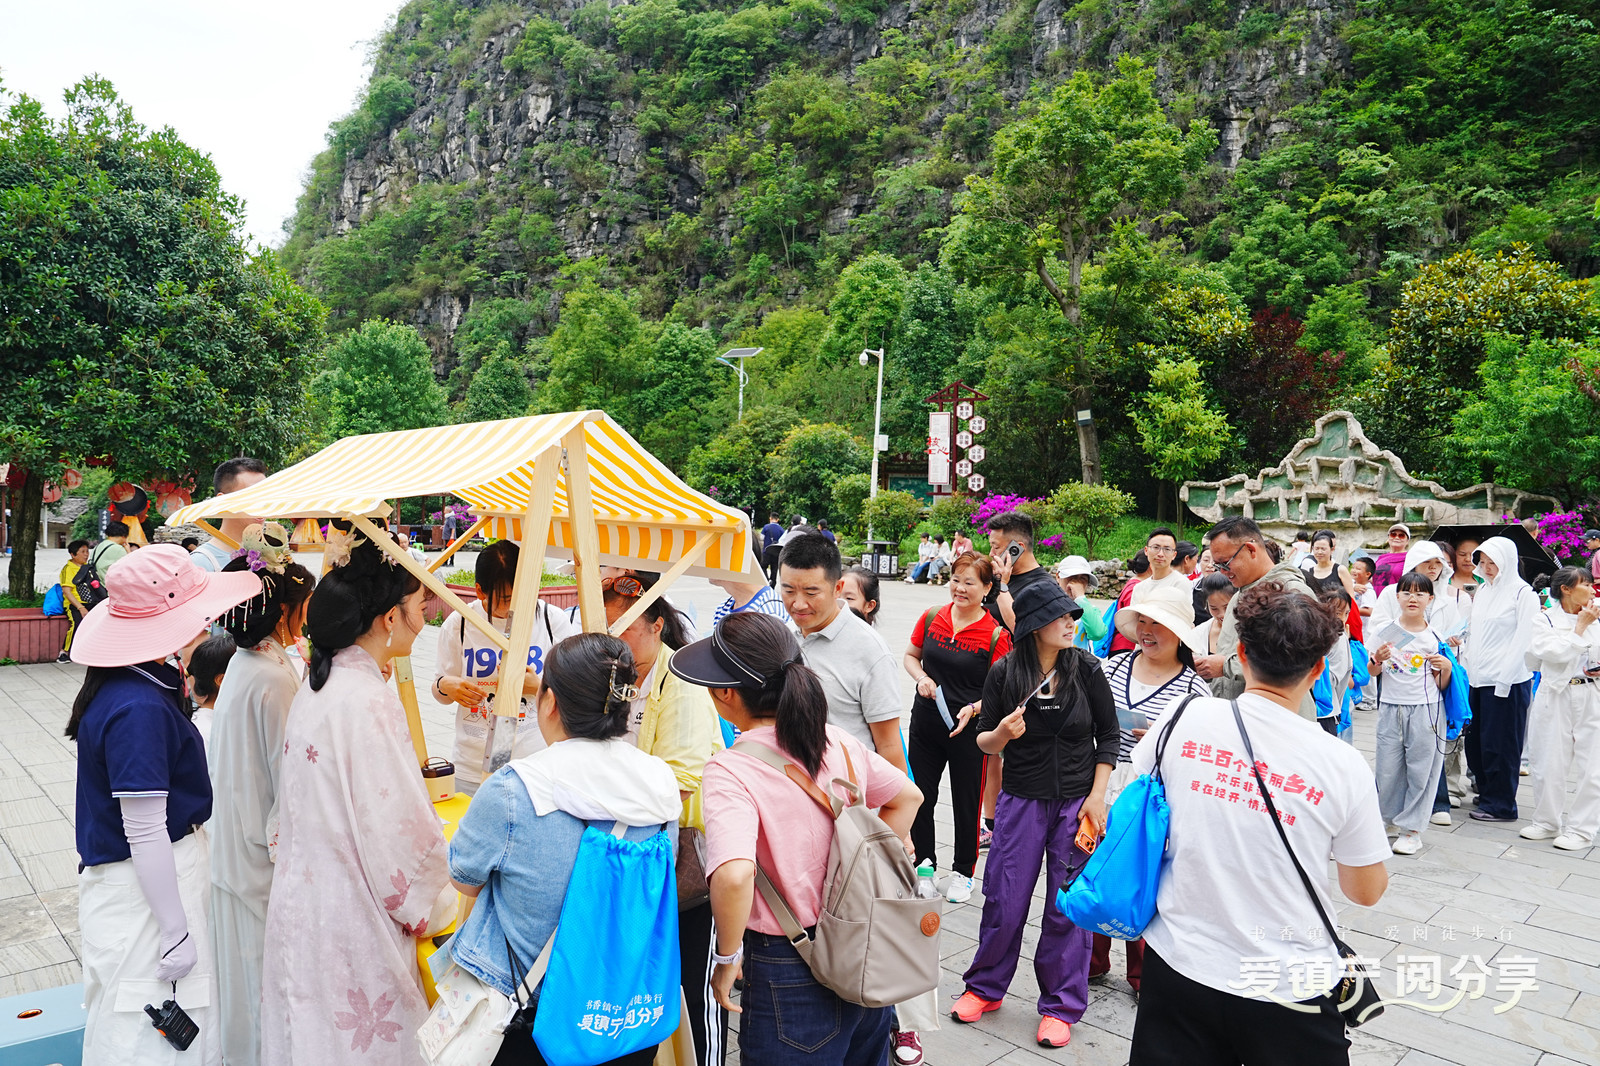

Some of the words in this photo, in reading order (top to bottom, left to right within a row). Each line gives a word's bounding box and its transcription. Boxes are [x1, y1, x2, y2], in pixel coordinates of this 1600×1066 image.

[464, 645, 544, 678] 198
[1180, 740, 1325, 806] 走进百个美丽乡村
[1216, 772, 1275, 799] 欢乐非
